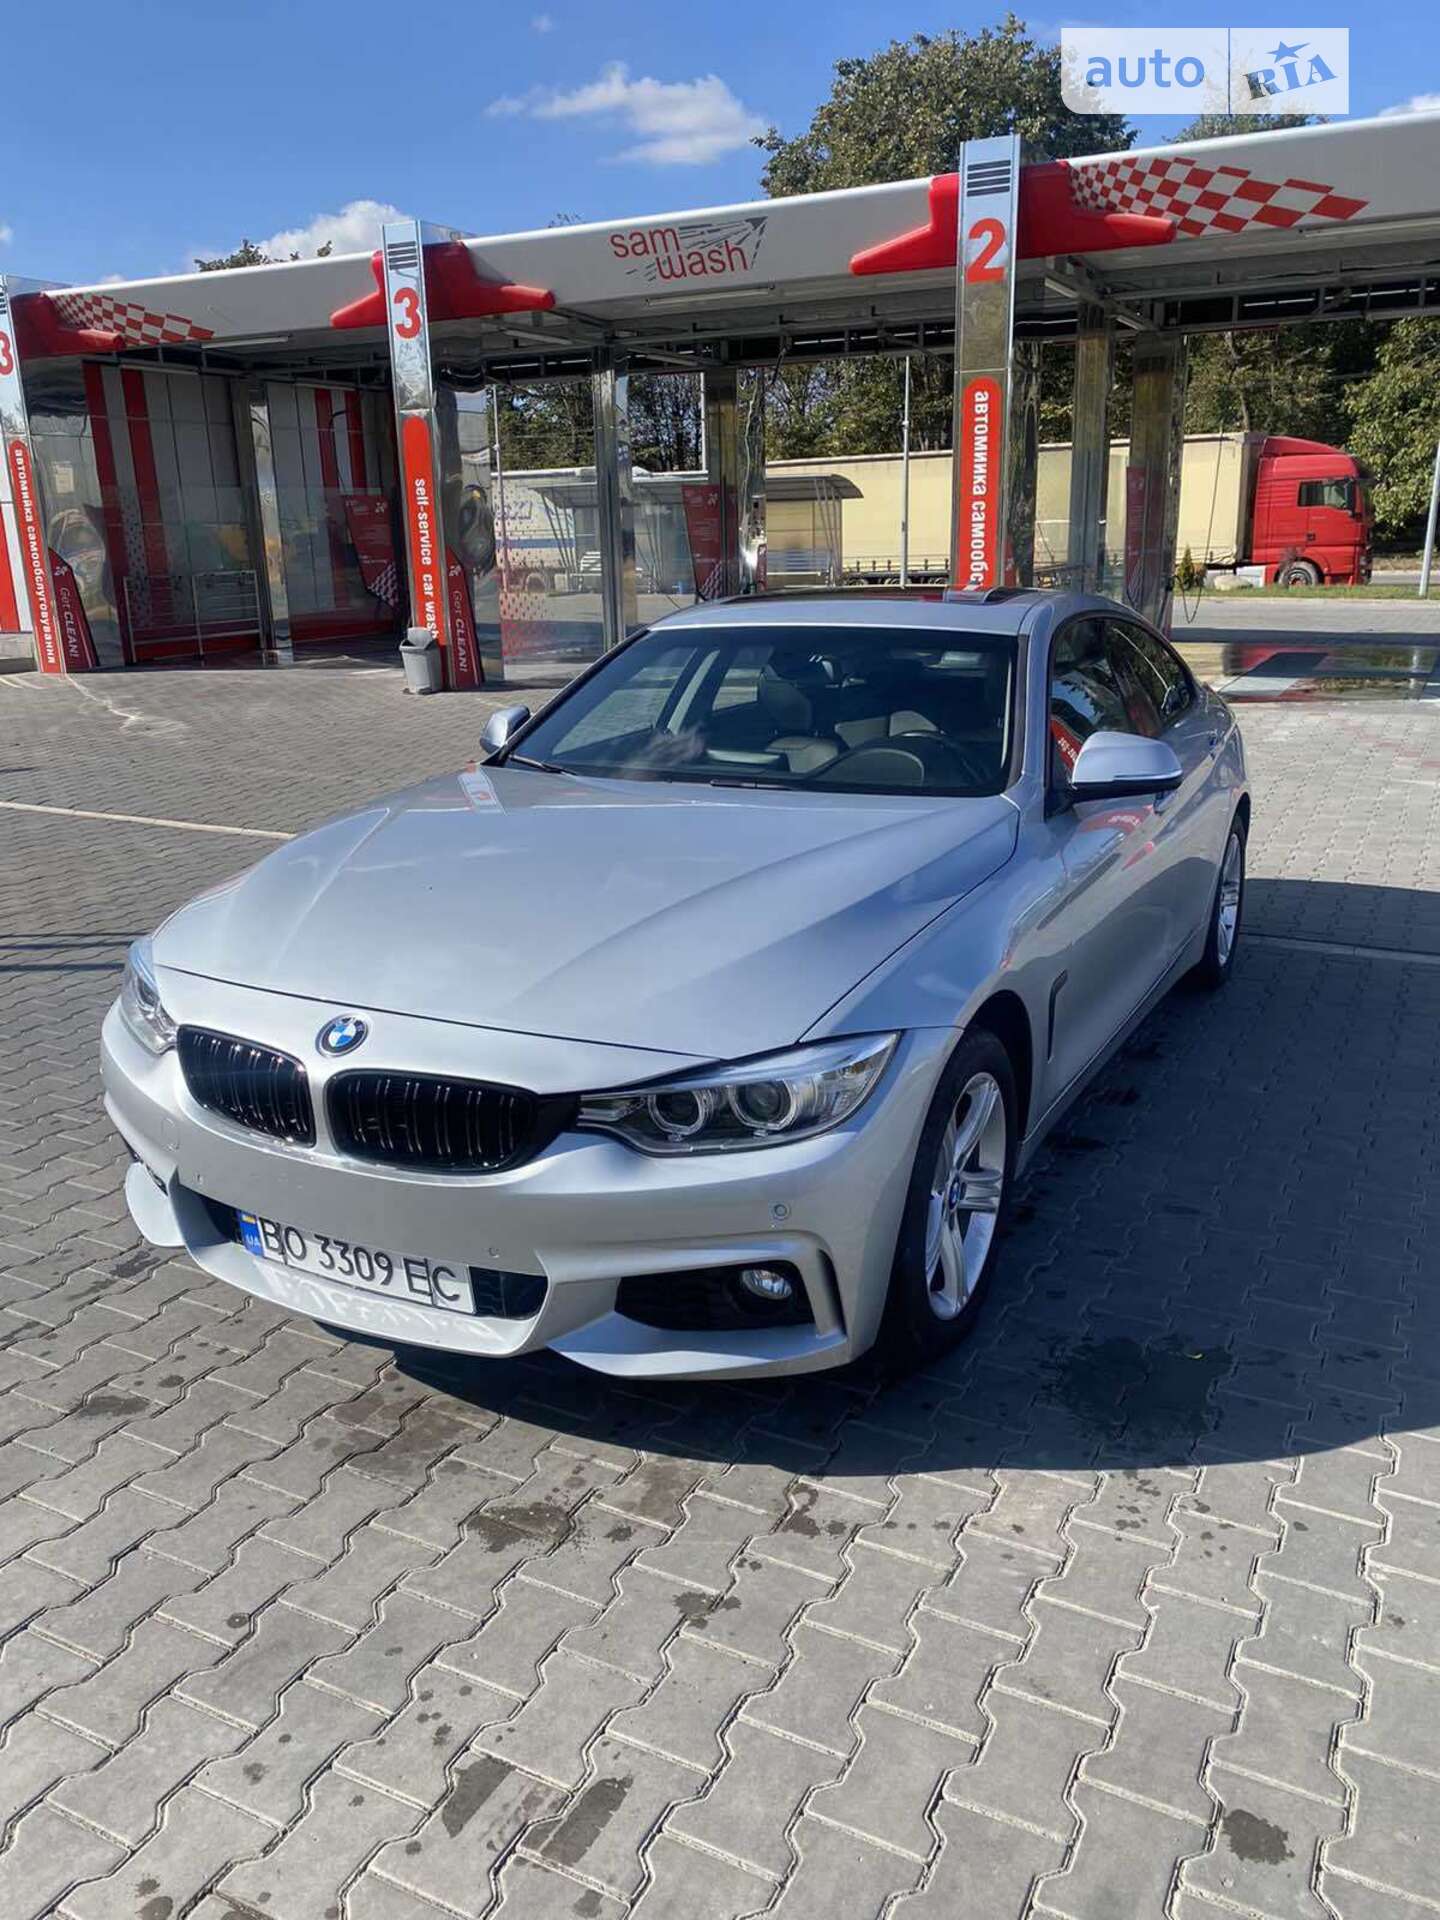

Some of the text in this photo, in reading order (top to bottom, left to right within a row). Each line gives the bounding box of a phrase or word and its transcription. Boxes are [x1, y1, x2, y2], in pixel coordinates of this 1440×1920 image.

[610, 228, 680, 258] sam
[656, 240, 748, 280] wash
[966, 217, 1006, 284] 2
[394, 288, 421, 339] 3
[415, 479, 432, 565] self-service
[970, 501, 988, 587] самообс
[422, 574, 434, 597] car
[258, 1216, 460, 1301] BO 3309 EC
